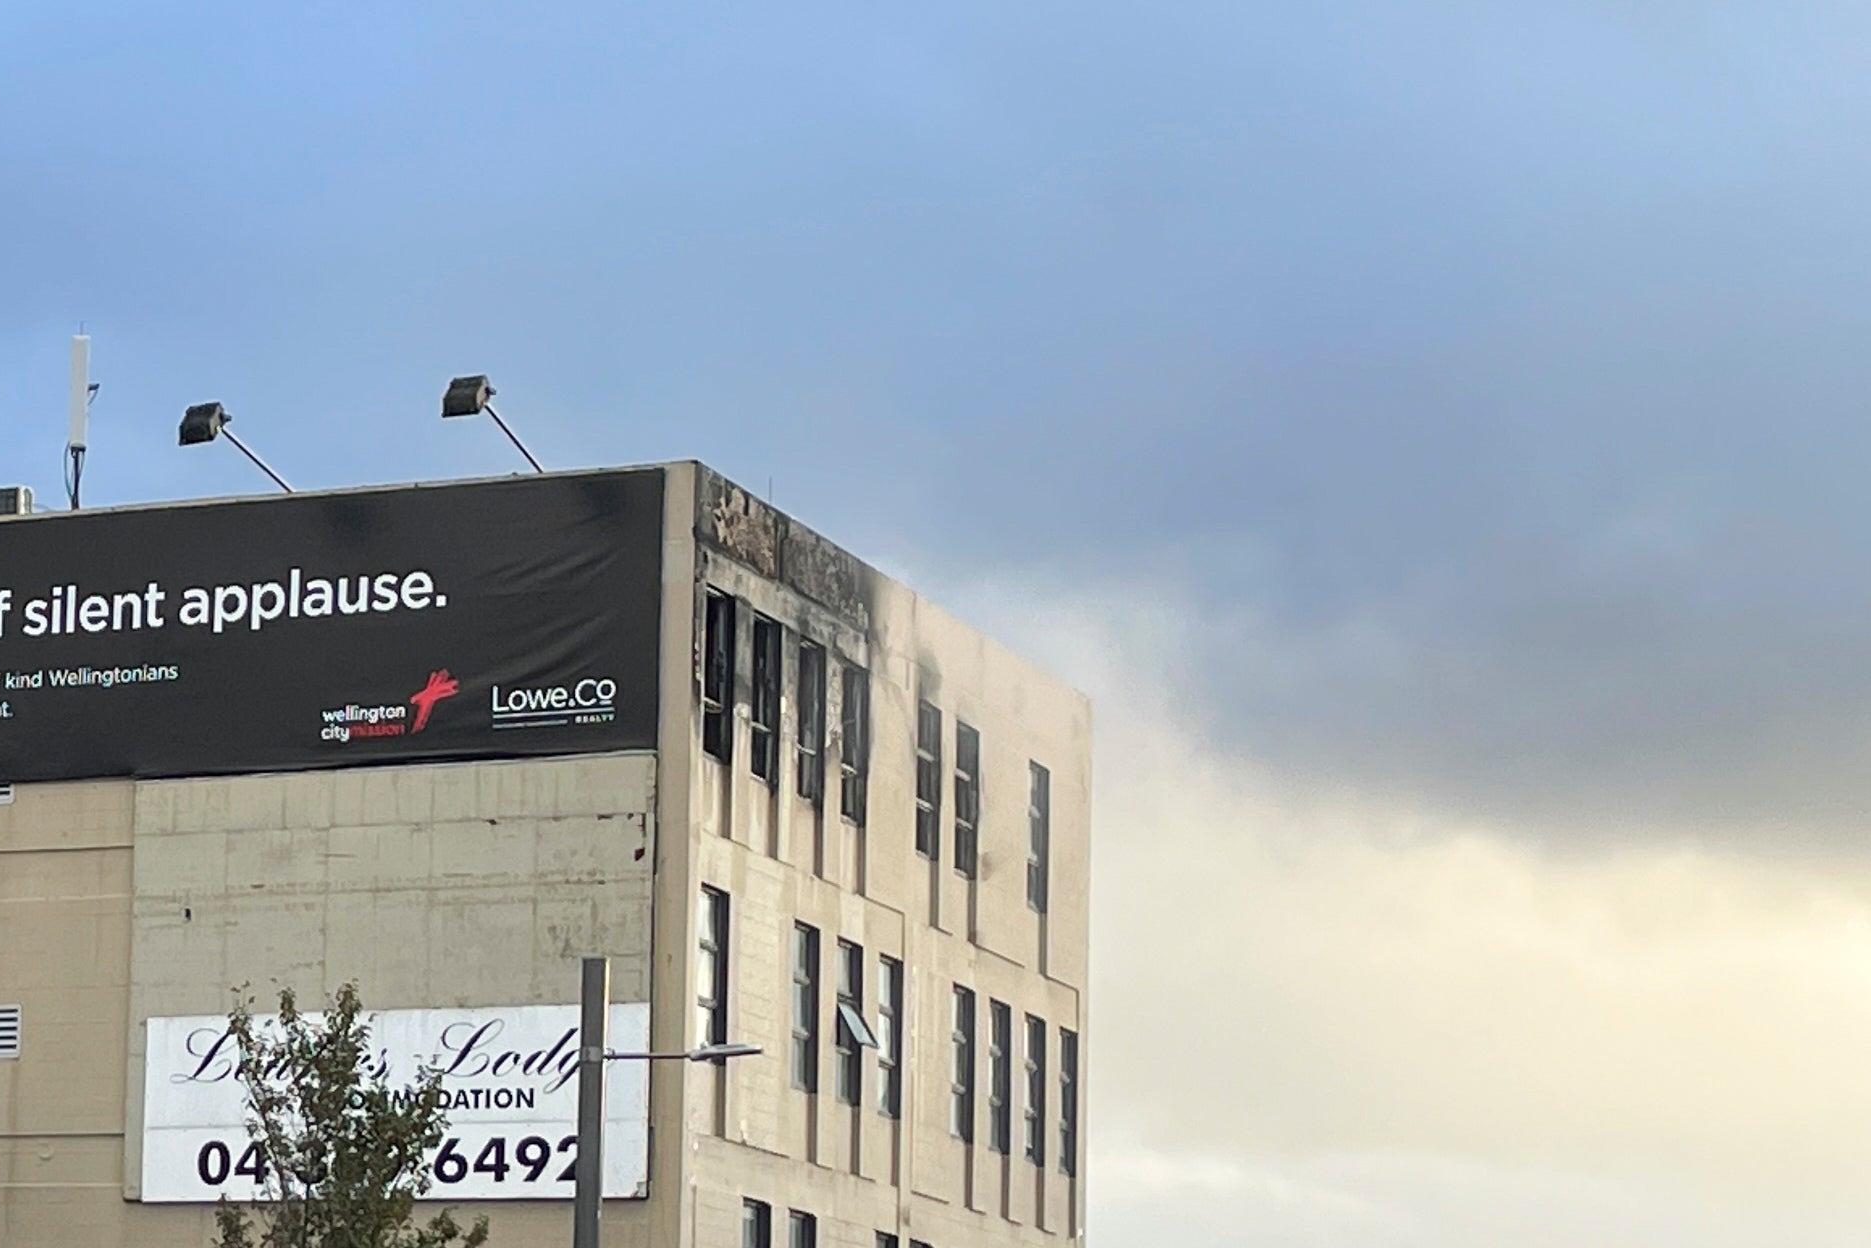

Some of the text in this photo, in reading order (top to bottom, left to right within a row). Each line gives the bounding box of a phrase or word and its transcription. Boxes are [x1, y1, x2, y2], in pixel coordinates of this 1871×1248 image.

[23, 582, 166, 636] silent
[178, 567, 447, 633] applause.
[5, 669, 43, 690] kind
[48, 663, 179, 690] Wellingtonians
[322, 704, 406, 724] wellington
[429, 1018, 583, 1094] Lodg
